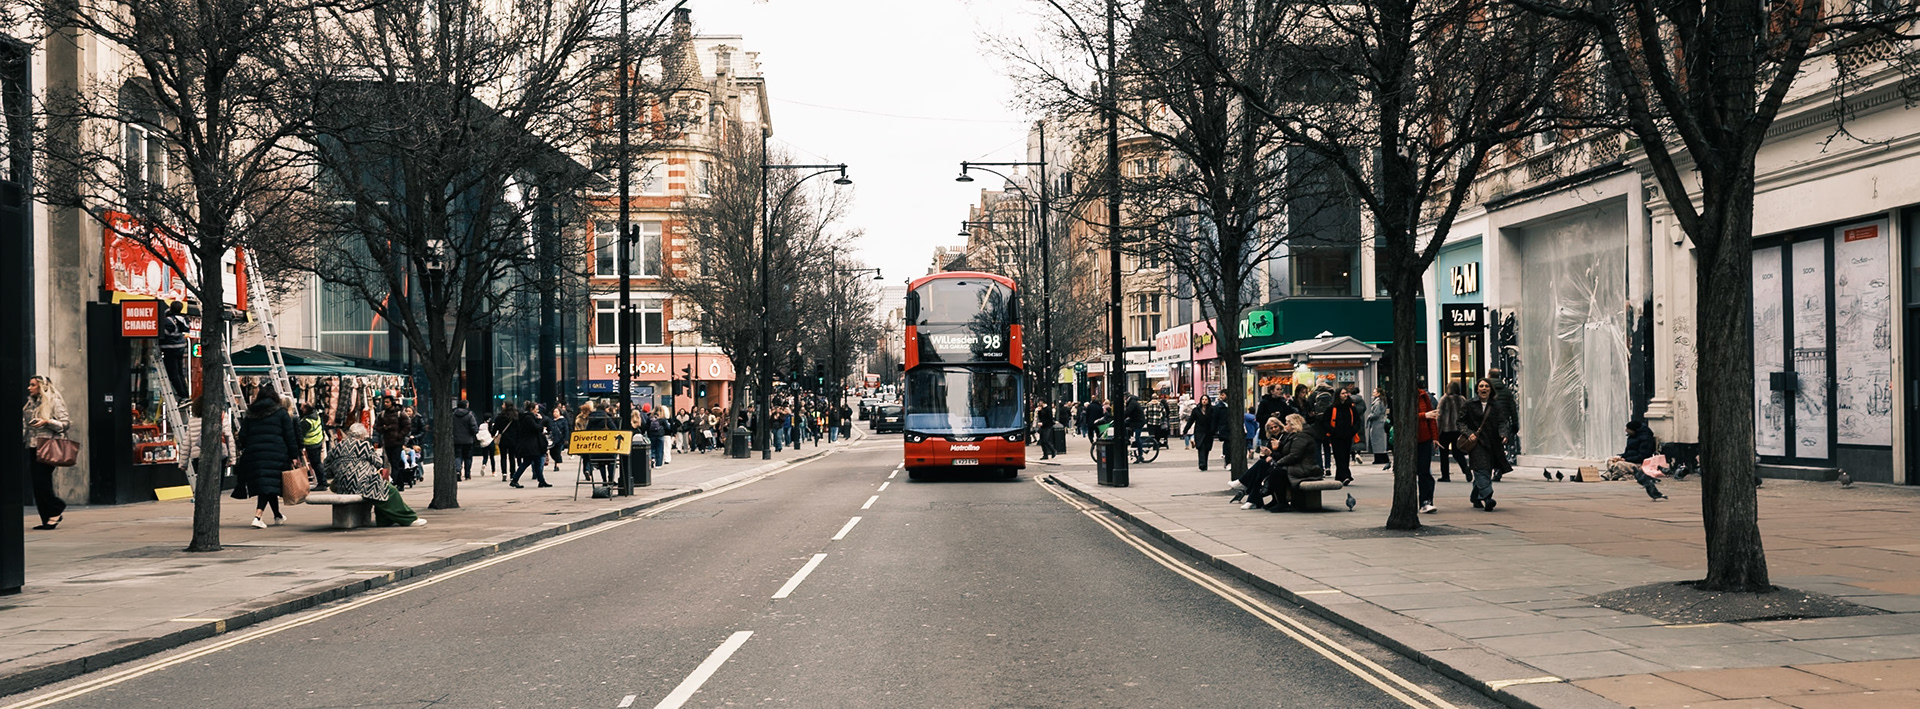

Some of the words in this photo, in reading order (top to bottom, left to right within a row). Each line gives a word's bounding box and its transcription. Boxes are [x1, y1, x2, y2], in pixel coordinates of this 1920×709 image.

[1803, 267, 1815, 275] SOON
[126, 307, 154, 317] MONEY
[124, 320, 156, 330] CHANGE
[930, 335, 978, 344] Willesden
[982, 335, 1001, 349] 98
[605, 360, 666, 374] PADORA
[573, 434, 608, 442] Diverted
[576, 442, 602, 450] traffic
